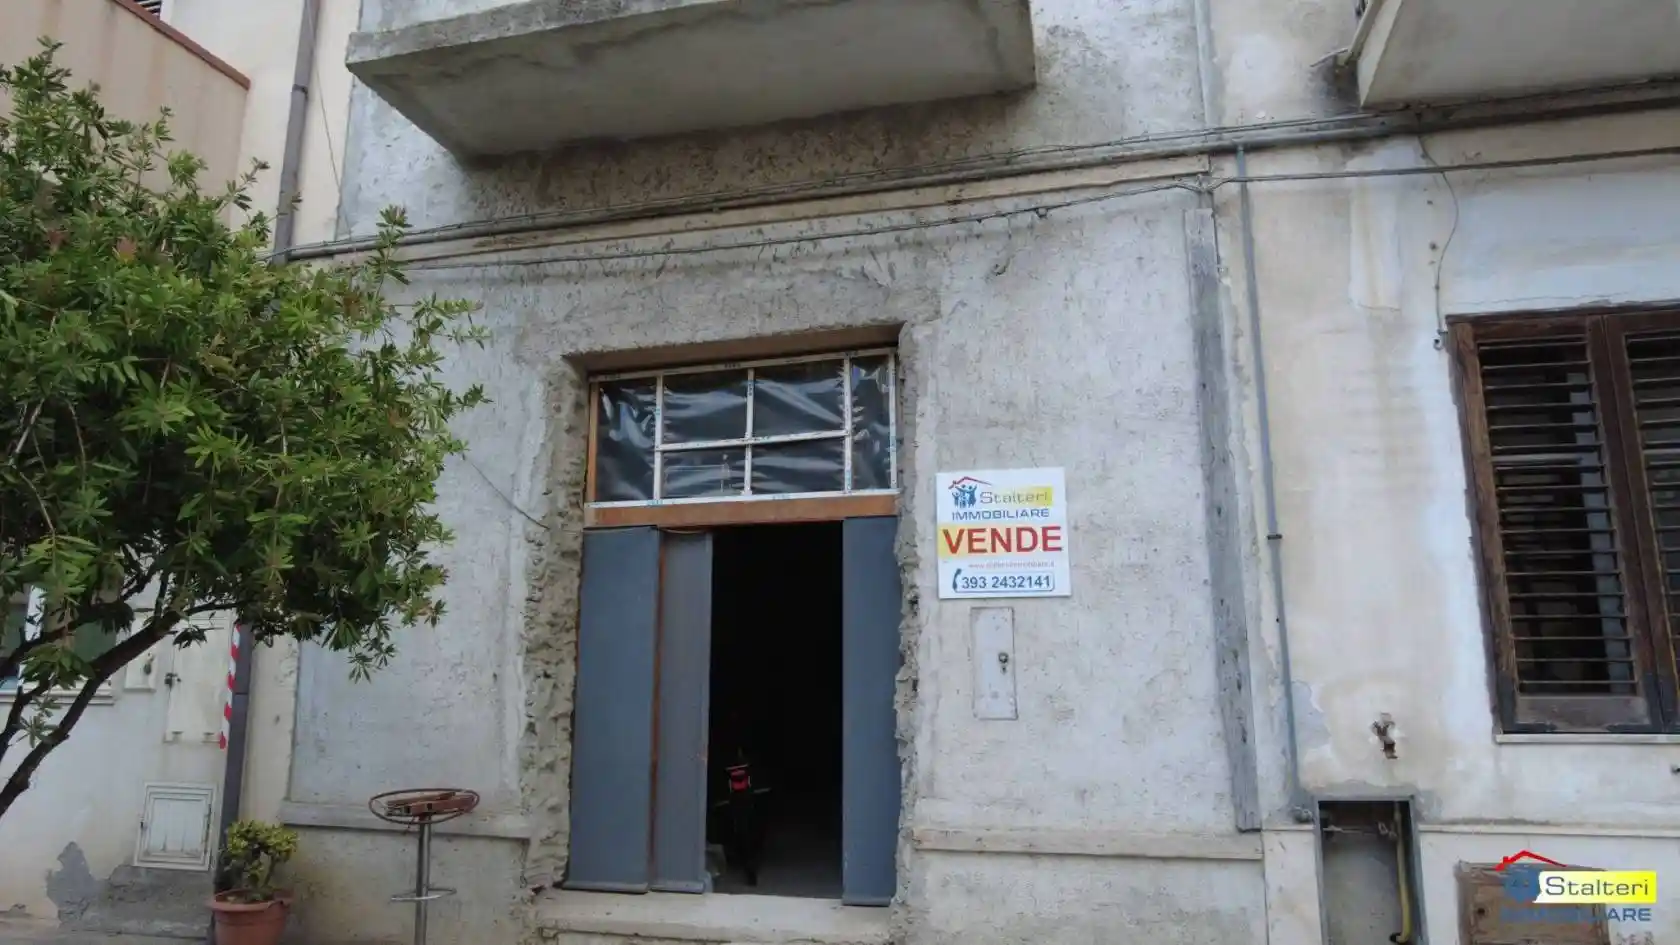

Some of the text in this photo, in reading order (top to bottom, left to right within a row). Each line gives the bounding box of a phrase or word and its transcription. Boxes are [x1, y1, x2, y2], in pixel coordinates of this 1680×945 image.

[980, 491, 1047, 504] Stalteri
[952, 509, 1049, 520] IMMOBILIARE
[942, 526, 1062, 554] VENDE
[961, 576, 1050, 589] 393 2432141
